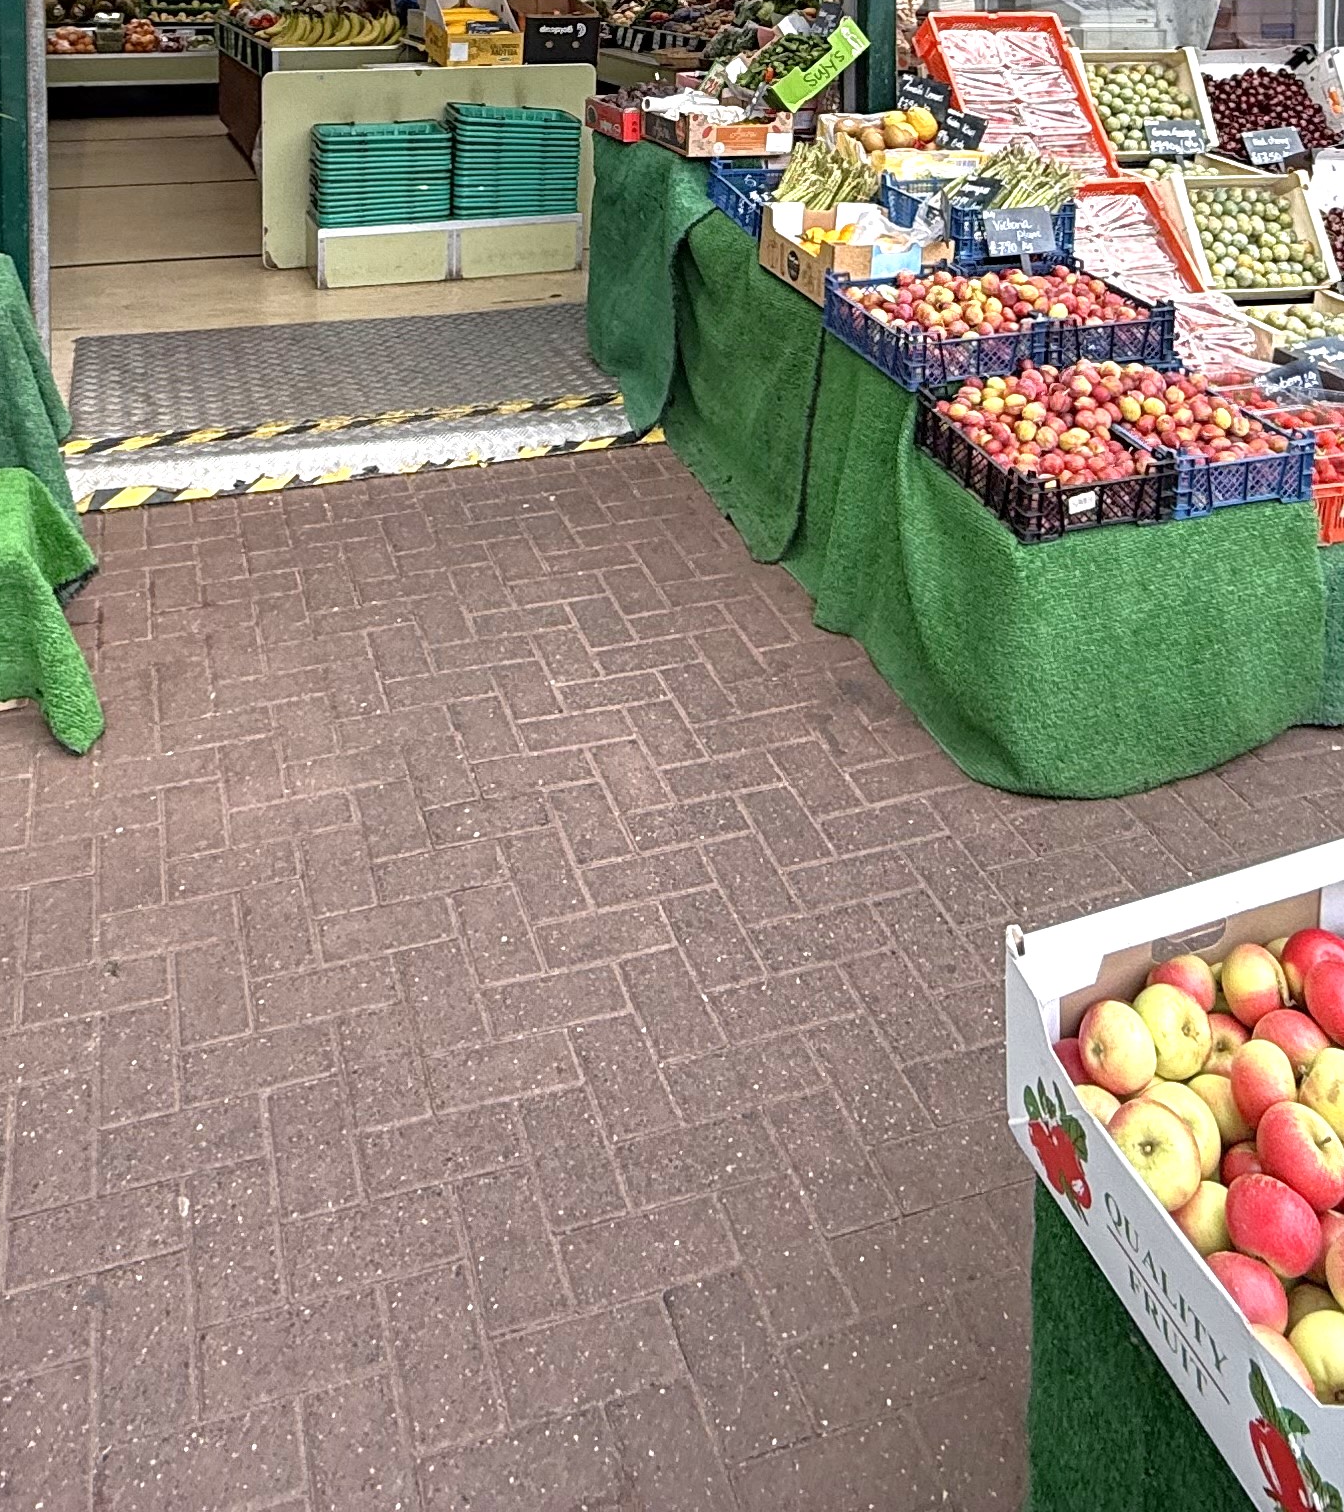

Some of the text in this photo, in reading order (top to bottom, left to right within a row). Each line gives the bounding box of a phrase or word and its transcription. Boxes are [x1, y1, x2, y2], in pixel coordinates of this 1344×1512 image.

[992, 218, 1033, 232] Victoria
[1104, 1191, 1229, 1375] QUALITY
[1128, 1263, 1207, 1397] FRUIT
